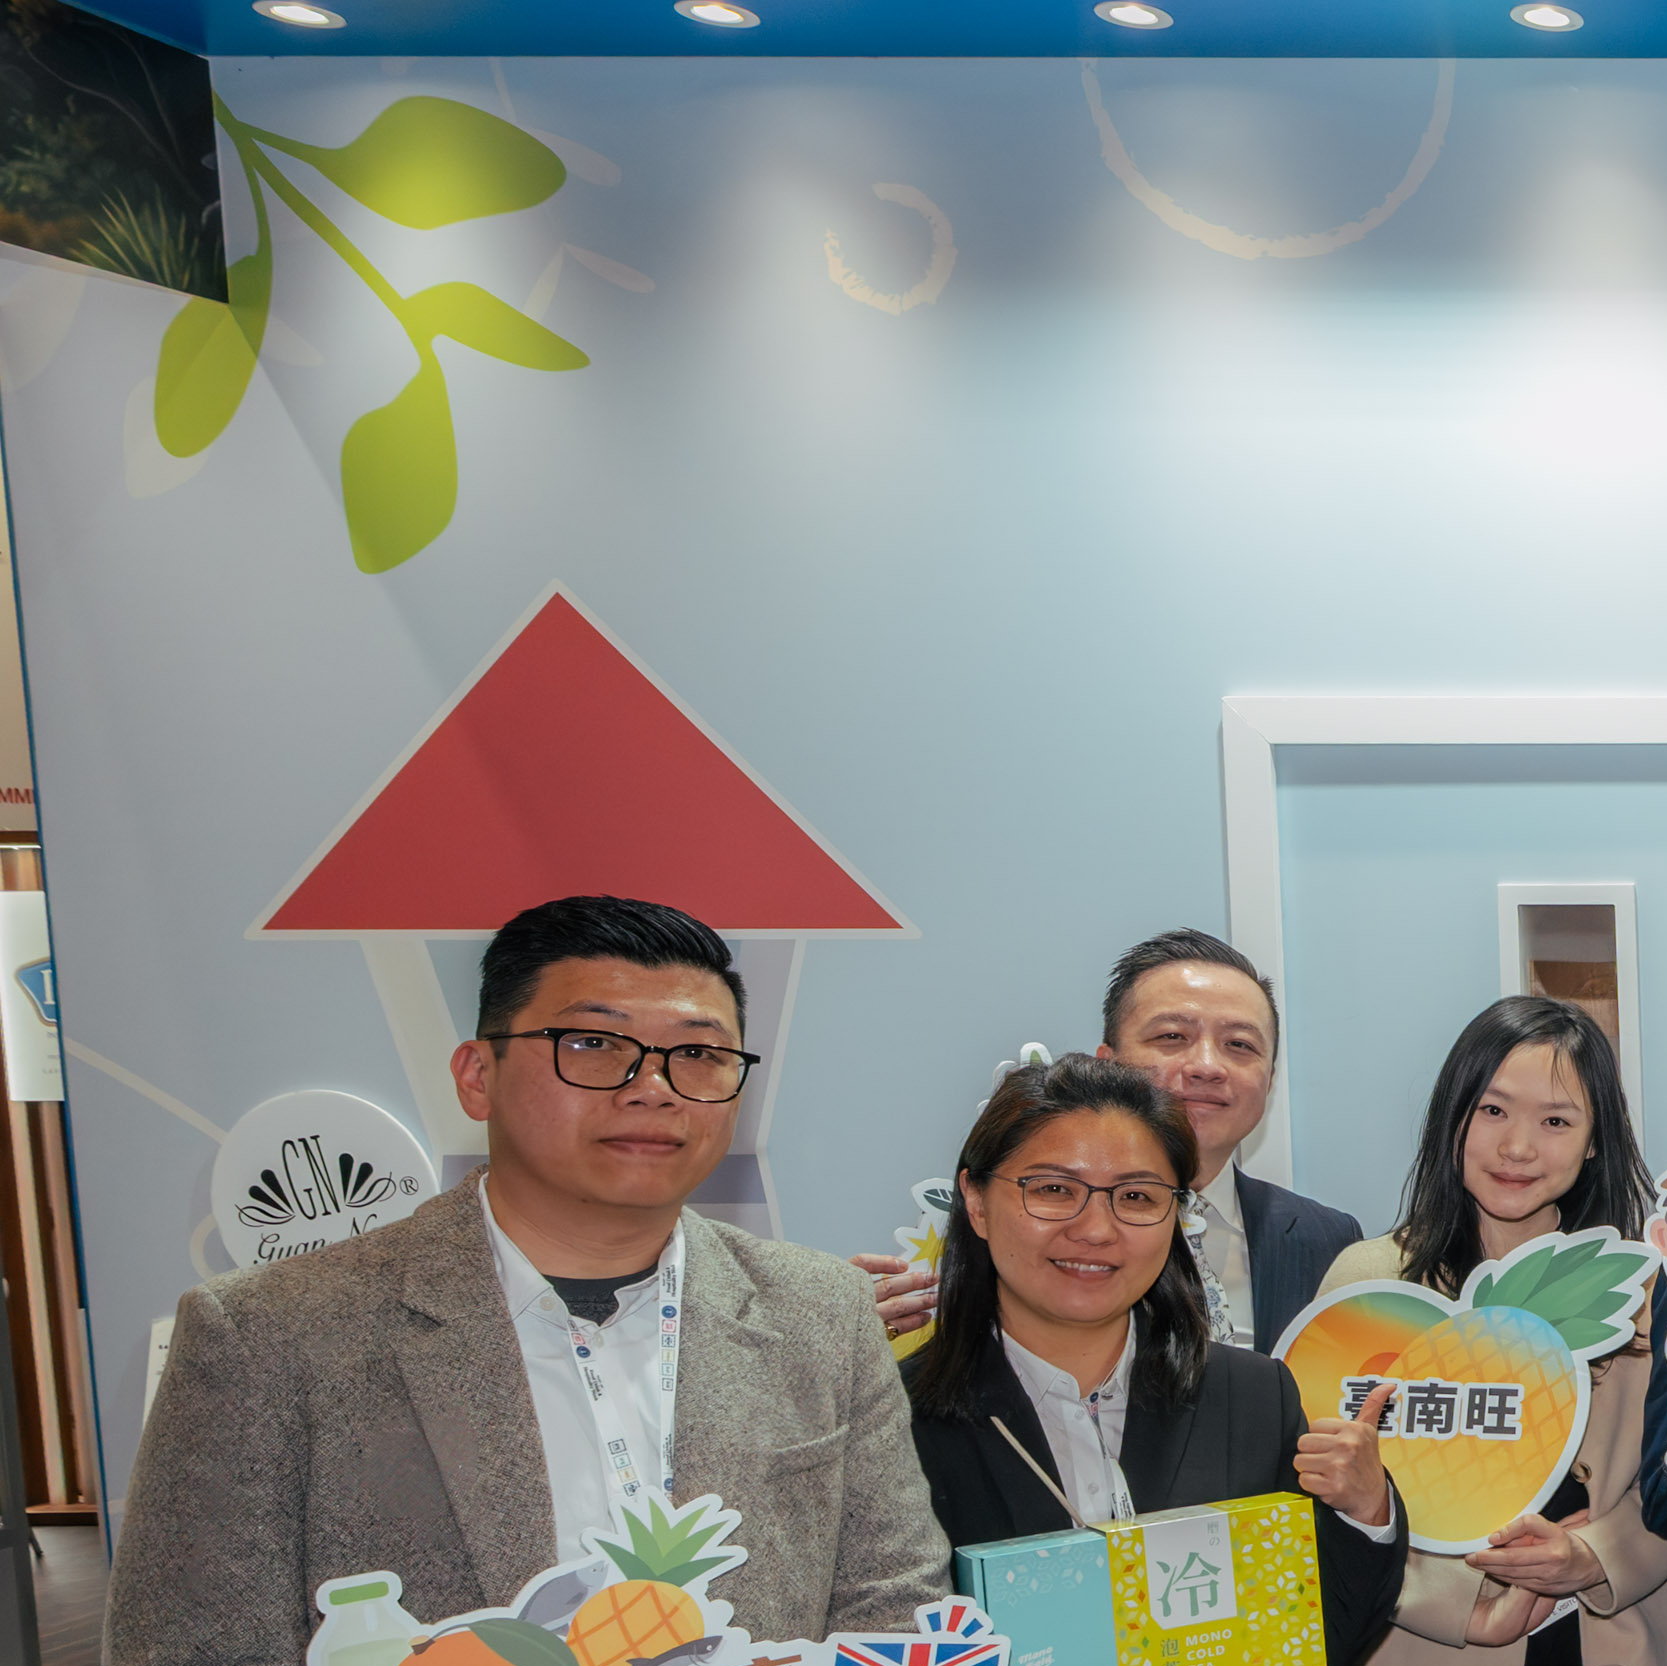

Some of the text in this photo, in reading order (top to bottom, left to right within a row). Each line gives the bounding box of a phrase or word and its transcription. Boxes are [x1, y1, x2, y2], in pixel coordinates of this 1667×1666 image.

[281, 1134, 341, 1221] GN
[1155, 1551, 1222, 1618] 冷
[1185, 1628, 1233, 1647] MONO
[1186, 1645, 1226, 1661] COLD
